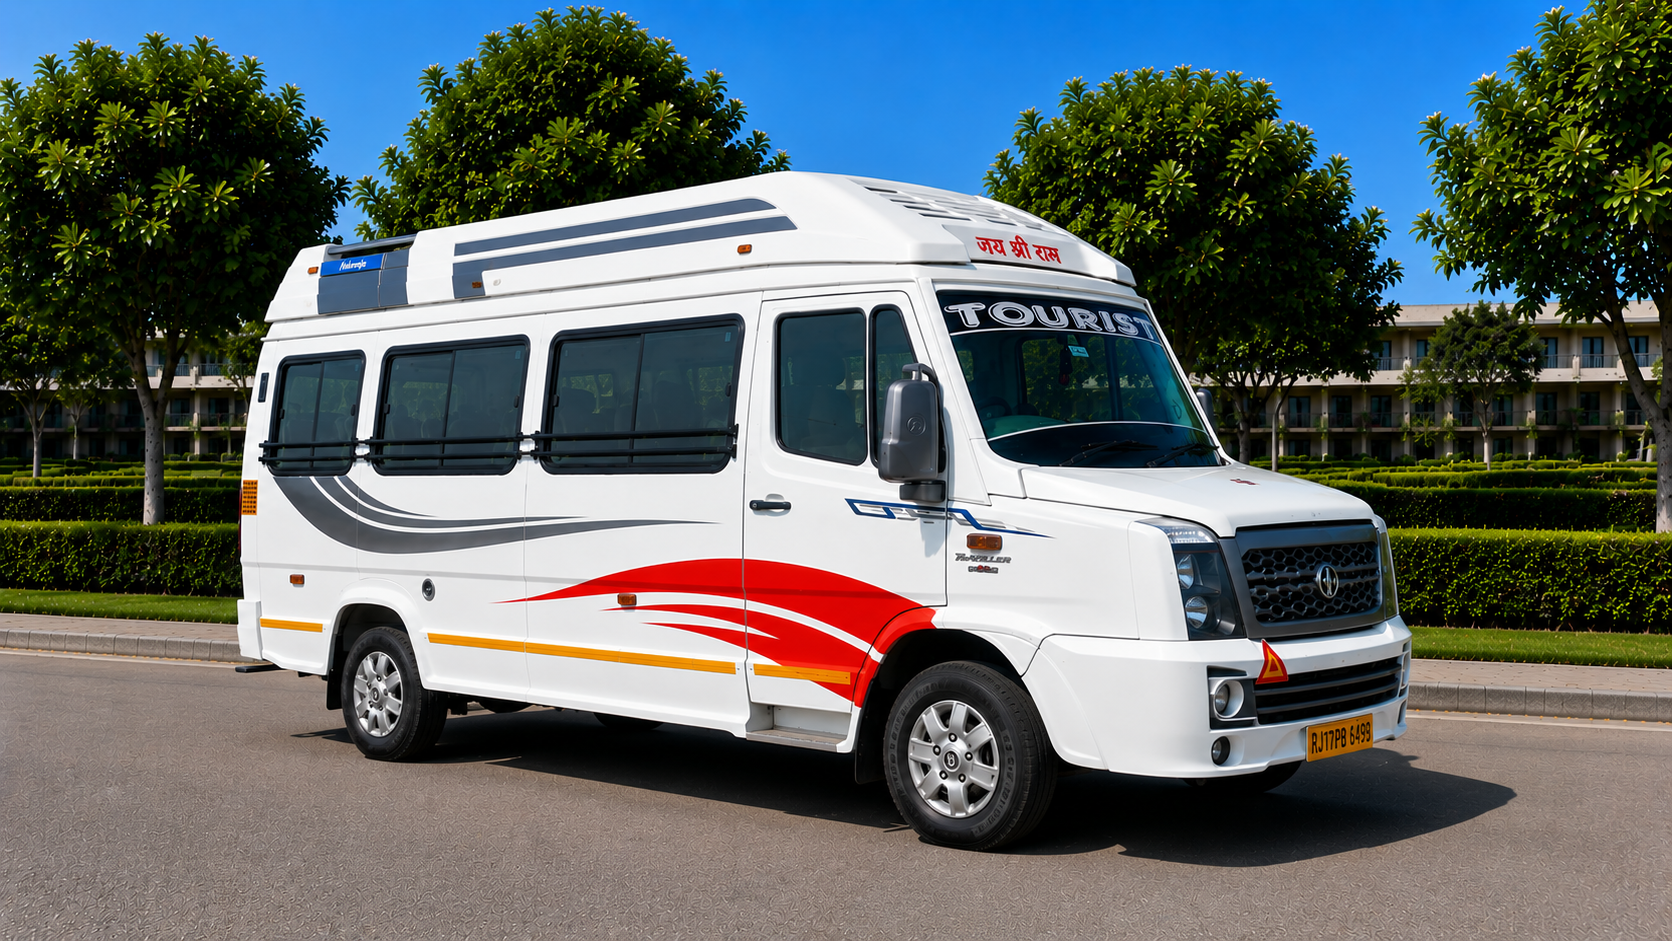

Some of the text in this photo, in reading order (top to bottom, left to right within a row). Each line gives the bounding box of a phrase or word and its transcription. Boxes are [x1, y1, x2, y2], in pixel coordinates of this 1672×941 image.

[975, 236, 1007, 256] जय
[1009, 235, 1032, 259] श्री
[944, 301, 1154, 340] TOURIST
[1311, 727, 1347, 754] RJ17PB
